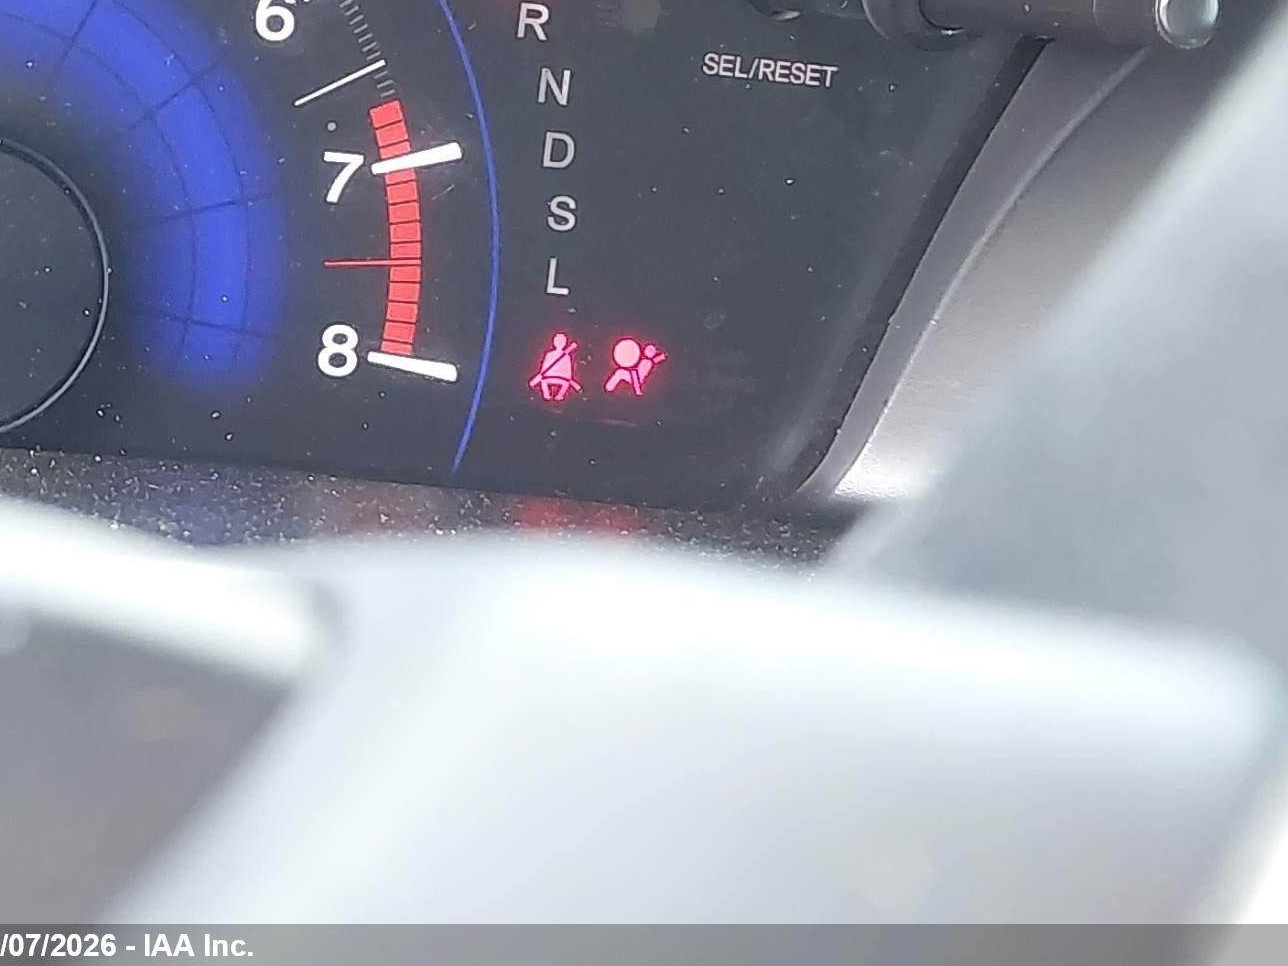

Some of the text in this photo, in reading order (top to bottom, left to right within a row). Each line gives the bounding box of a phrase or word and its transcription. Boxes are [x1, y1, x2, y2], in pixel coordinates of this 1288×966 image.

[517, 1, 550, 41] R
[537, 67, 572, 106] N
[702, 52, 838, 87] SEL/RESET
[543, 131, 576, 170] D
[323, 151, 365, 204] 7
[547, 195, 578, 232] S
[546, 257, 570, 296] L
[317, 323, 360, 378] 8
